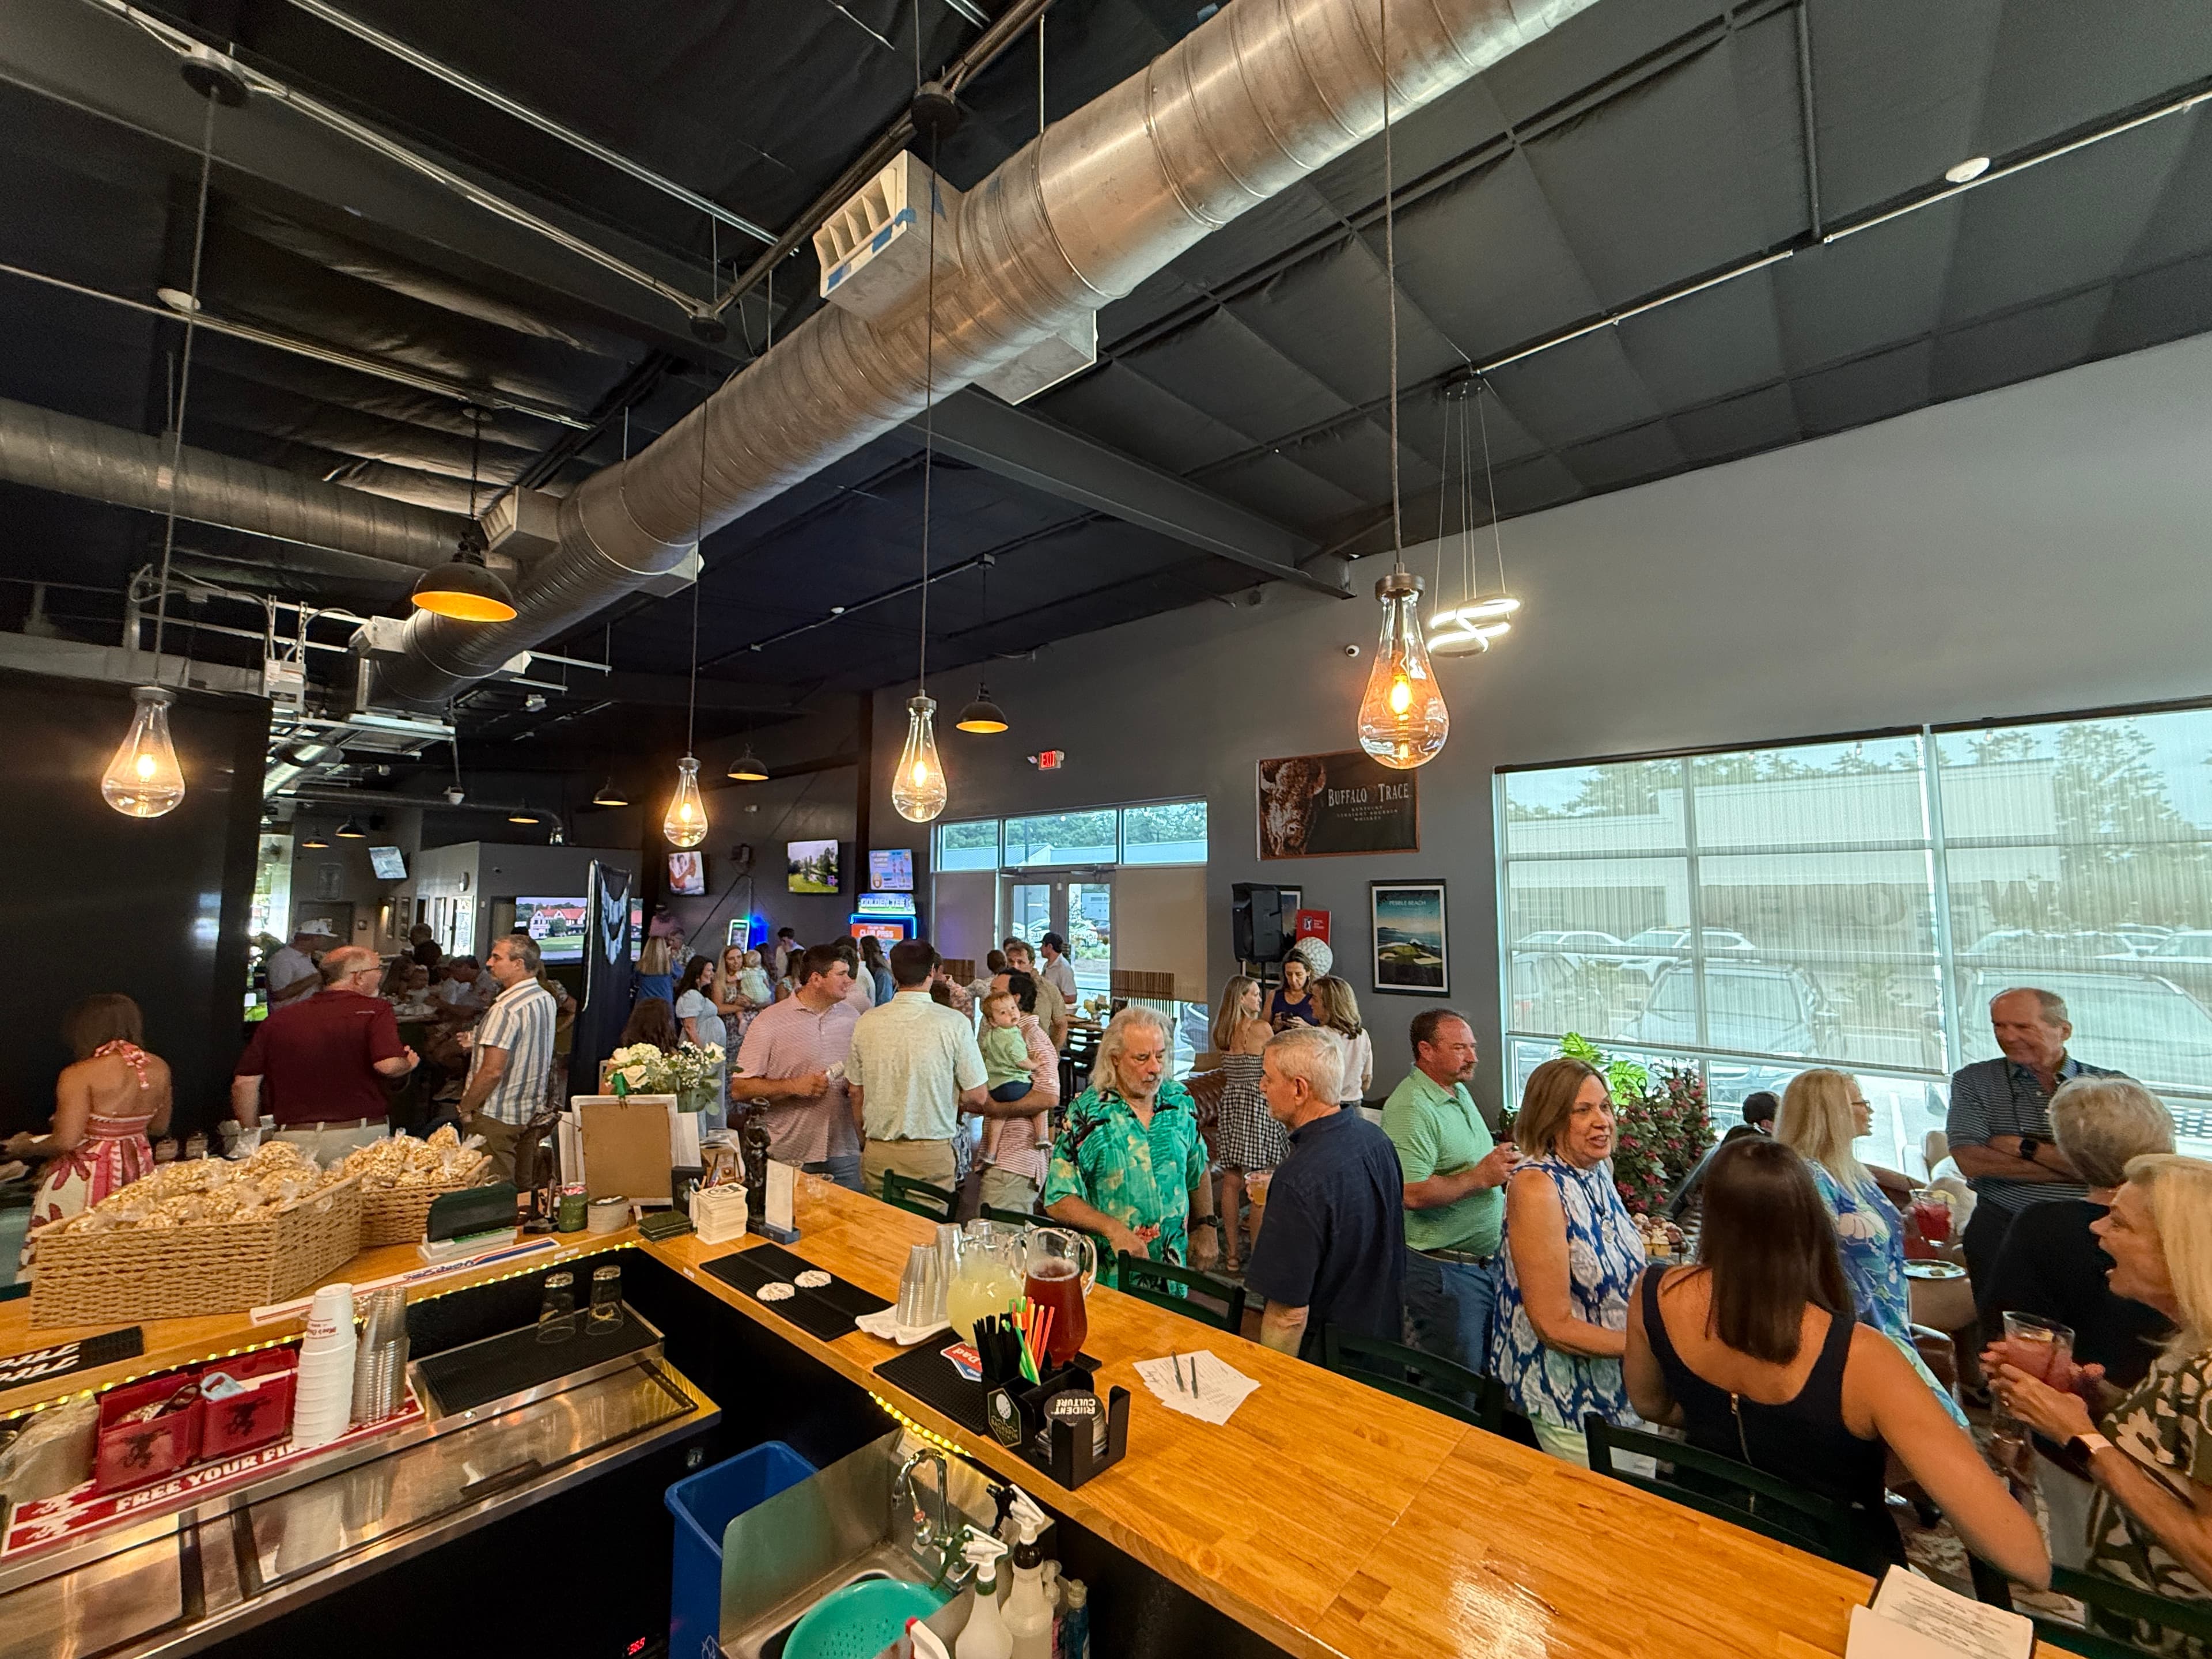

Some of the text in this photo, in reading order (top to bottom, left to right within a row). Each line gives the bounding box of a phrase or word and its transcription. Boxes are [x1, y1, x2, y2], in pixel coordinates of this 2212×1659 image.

[1040, 751, 1055, 768] EXIT
[861, 898, 905, 908] GOLDEN TEE
[1055, 1398, 1096, 1407] CULTURE
[116, 1479, 183, 1513] FREE
[185, 1455, 259, 1487] YOUR
